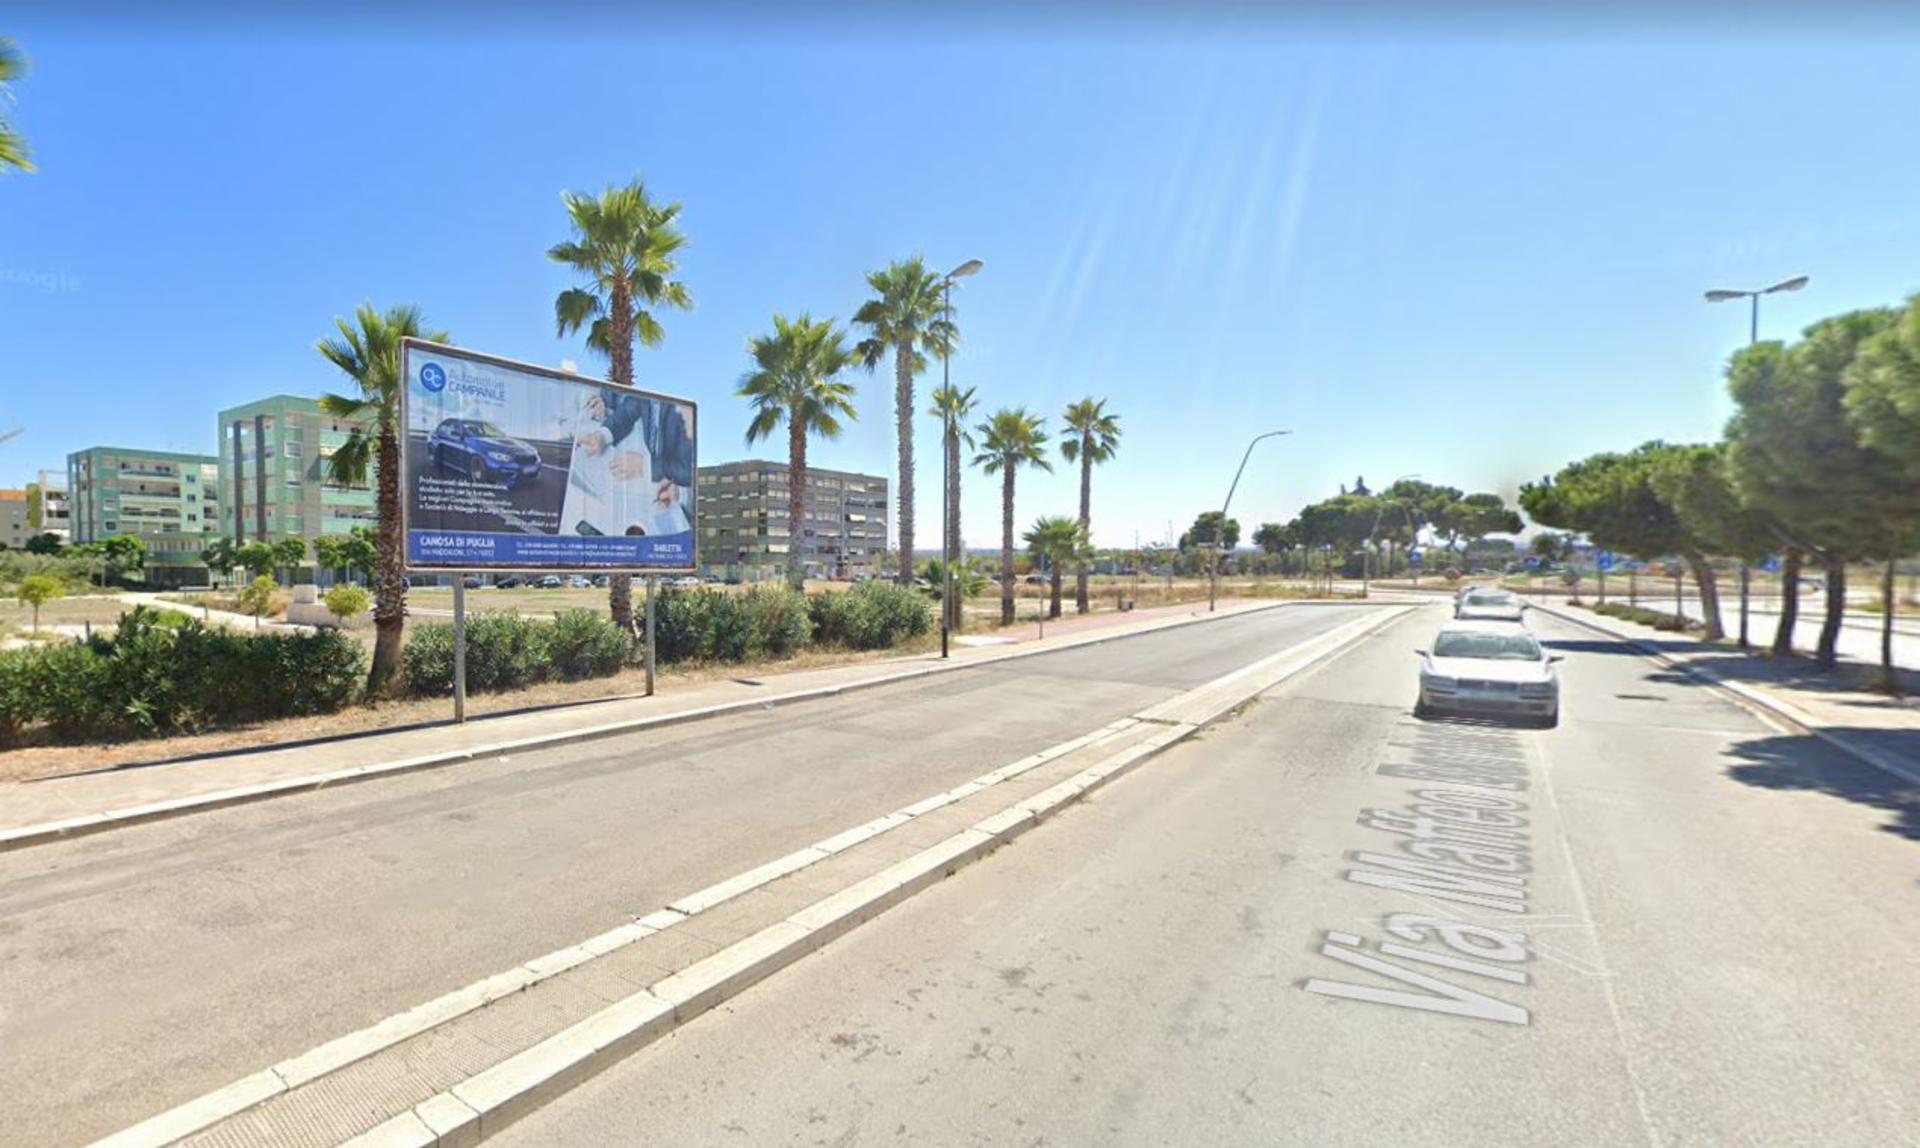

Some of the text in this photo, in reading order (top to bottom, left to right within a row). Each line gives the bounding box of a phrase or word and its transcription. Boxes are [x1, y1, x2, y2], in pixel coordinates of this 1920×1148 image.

[420, 535, 495, 548] CANOSA DI PUGLIA
